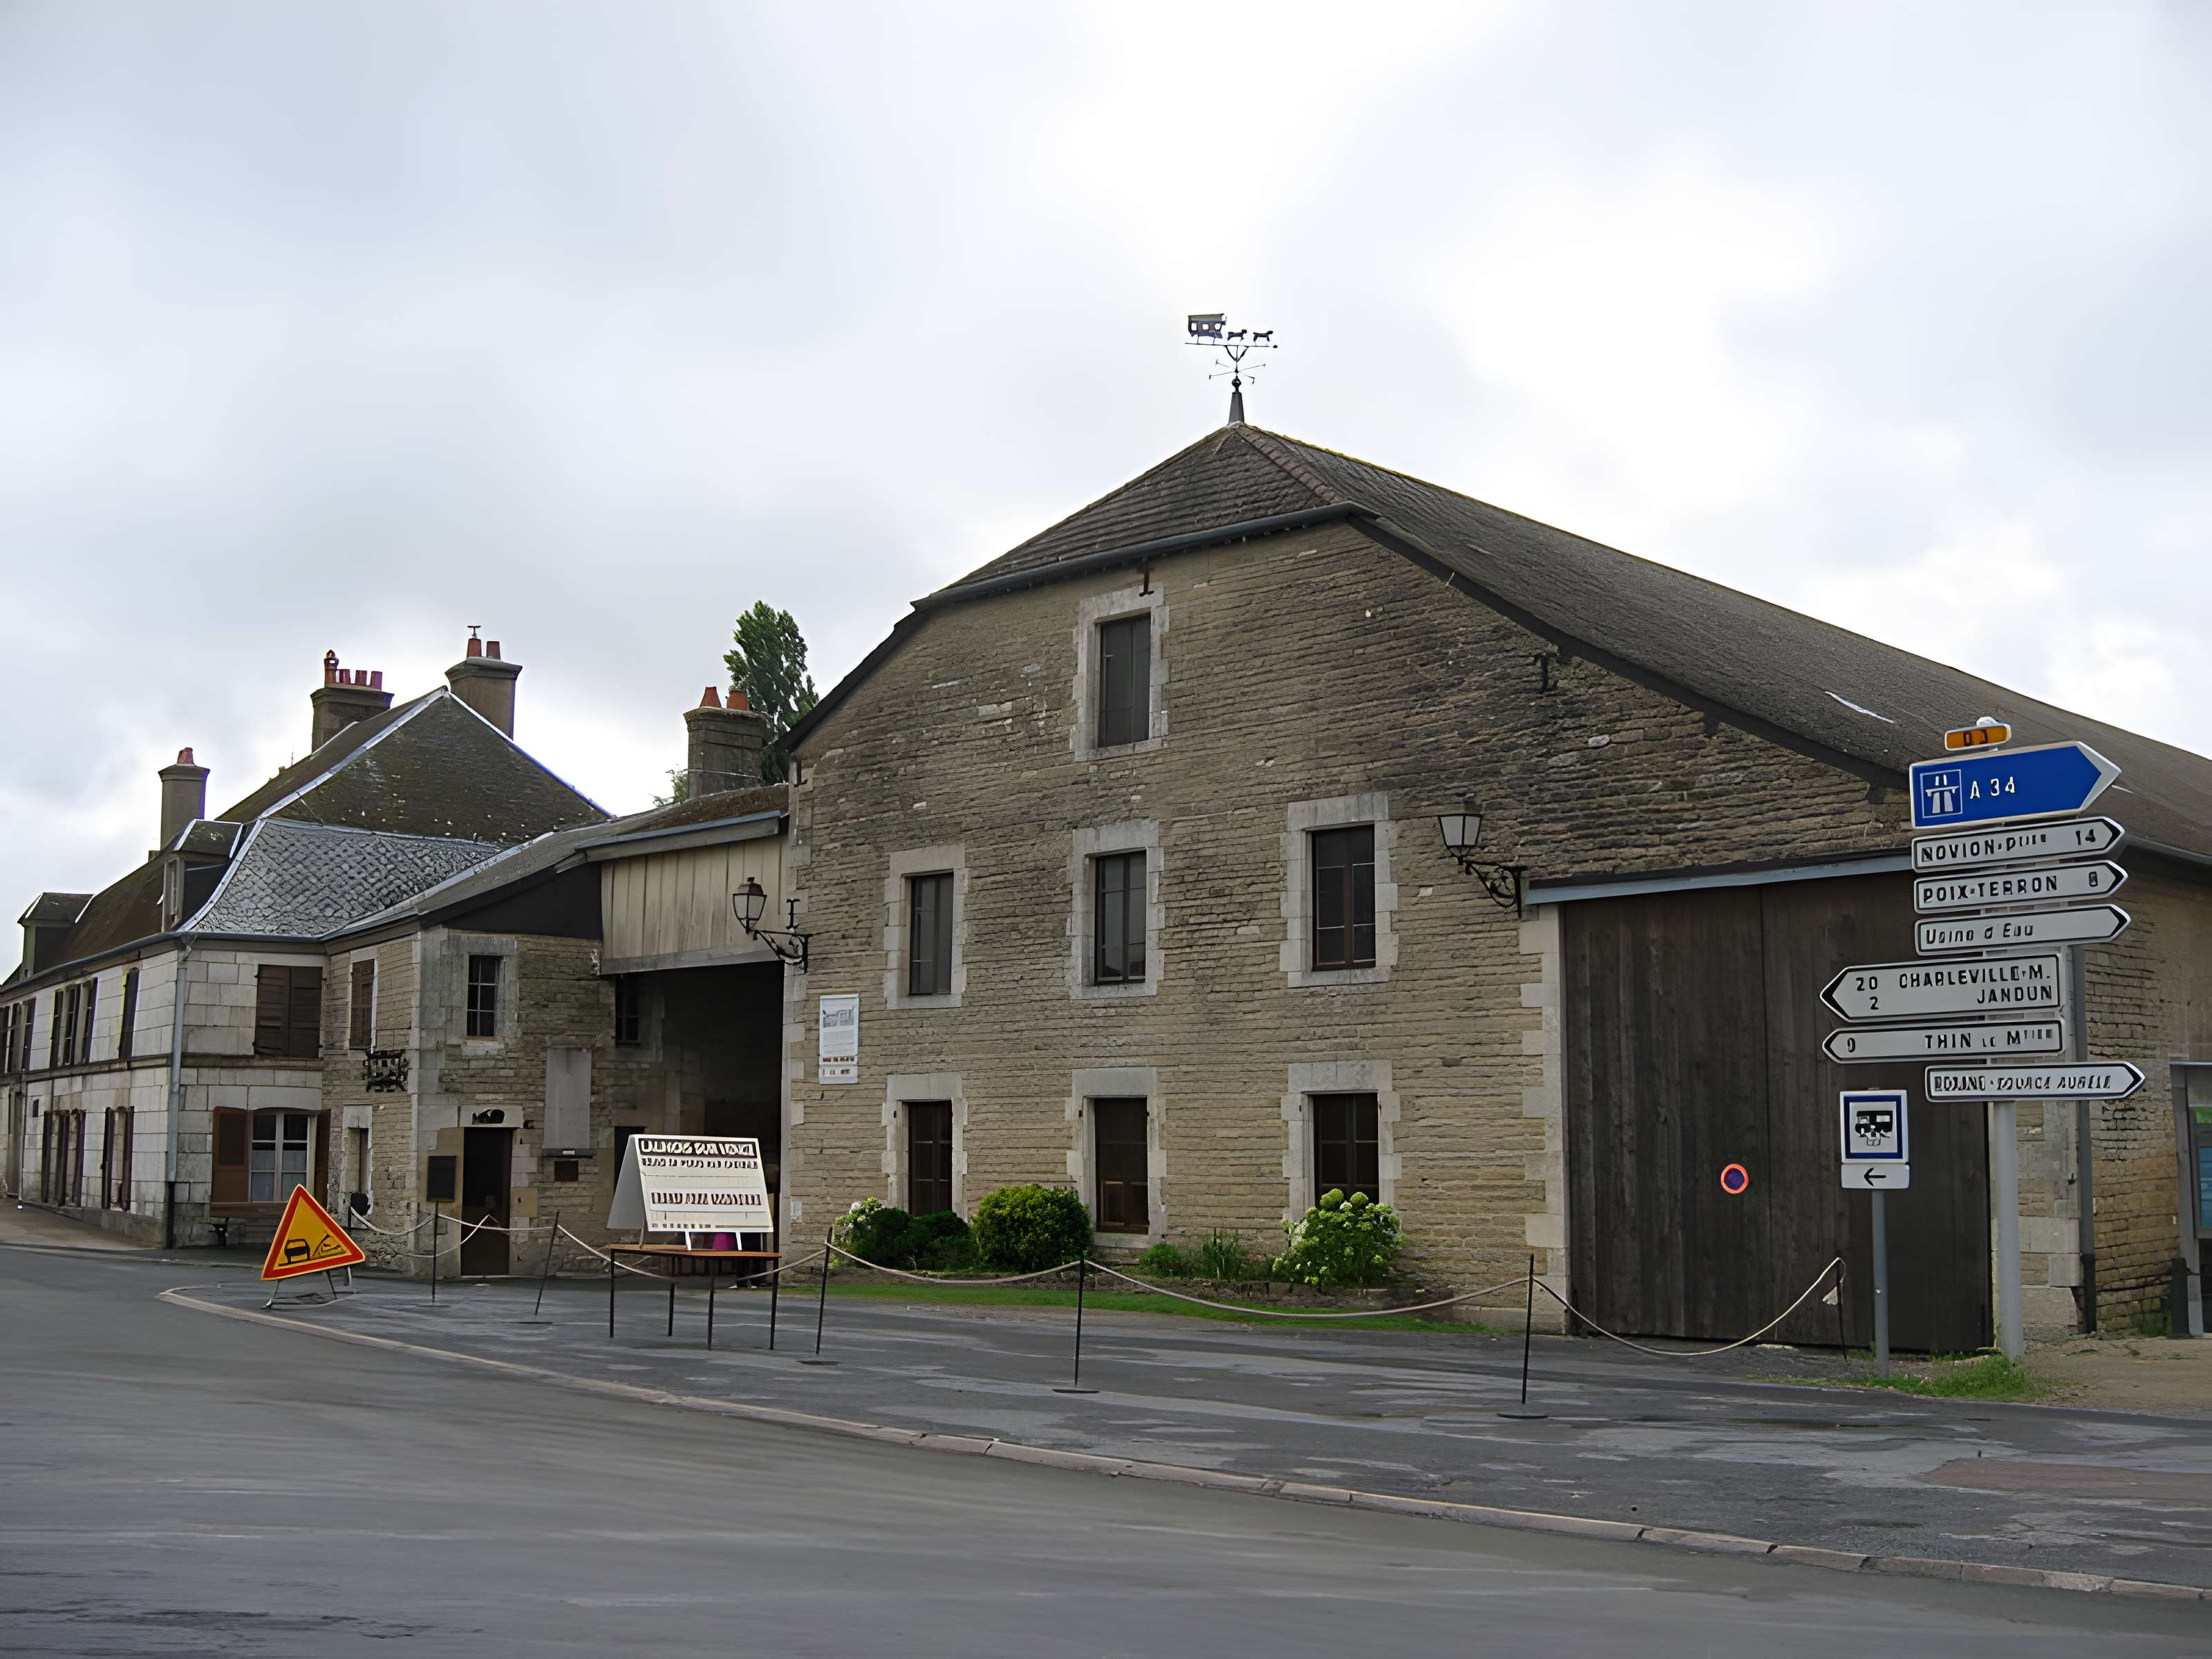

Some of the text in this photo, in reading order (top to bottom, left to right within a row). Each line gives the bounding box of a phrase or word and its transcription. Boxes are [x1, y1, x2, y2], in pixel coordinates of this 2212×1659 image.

[1969, 776, 2015, 800] A 34
[1921, 829, 2096, 863] NOVION-P 14
[1923, 875, 2057, 903] POIX-TERRON
[1855, 976, 1878, 991] 20
[1869, 985, 2052, 1011] 2 JANDUN
[1924, 1032, 1971, 1049] THIN
